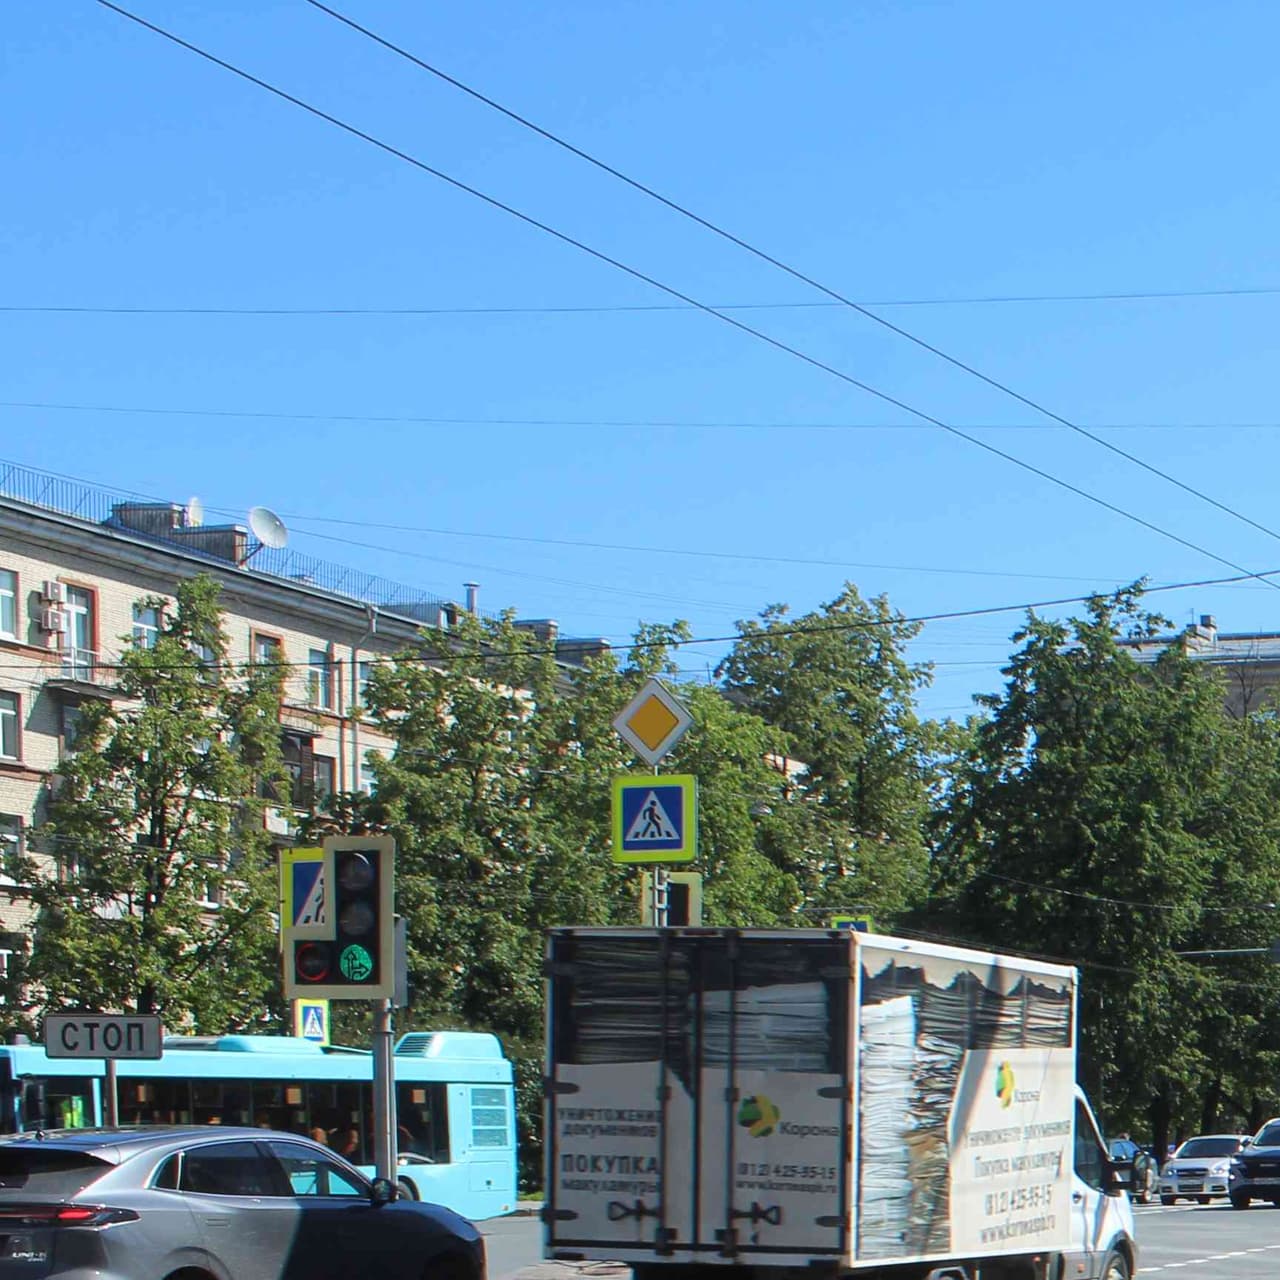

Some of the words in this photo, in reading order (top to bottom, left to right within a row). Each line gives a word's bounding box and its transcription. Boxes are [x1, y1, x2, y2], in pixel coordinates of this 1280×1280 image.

[61, 1022, 144, 1051] СТОП
[780, 1121, 839, 1139] Корона
[562, 1154, 661, 1175] ПОКУПКА
